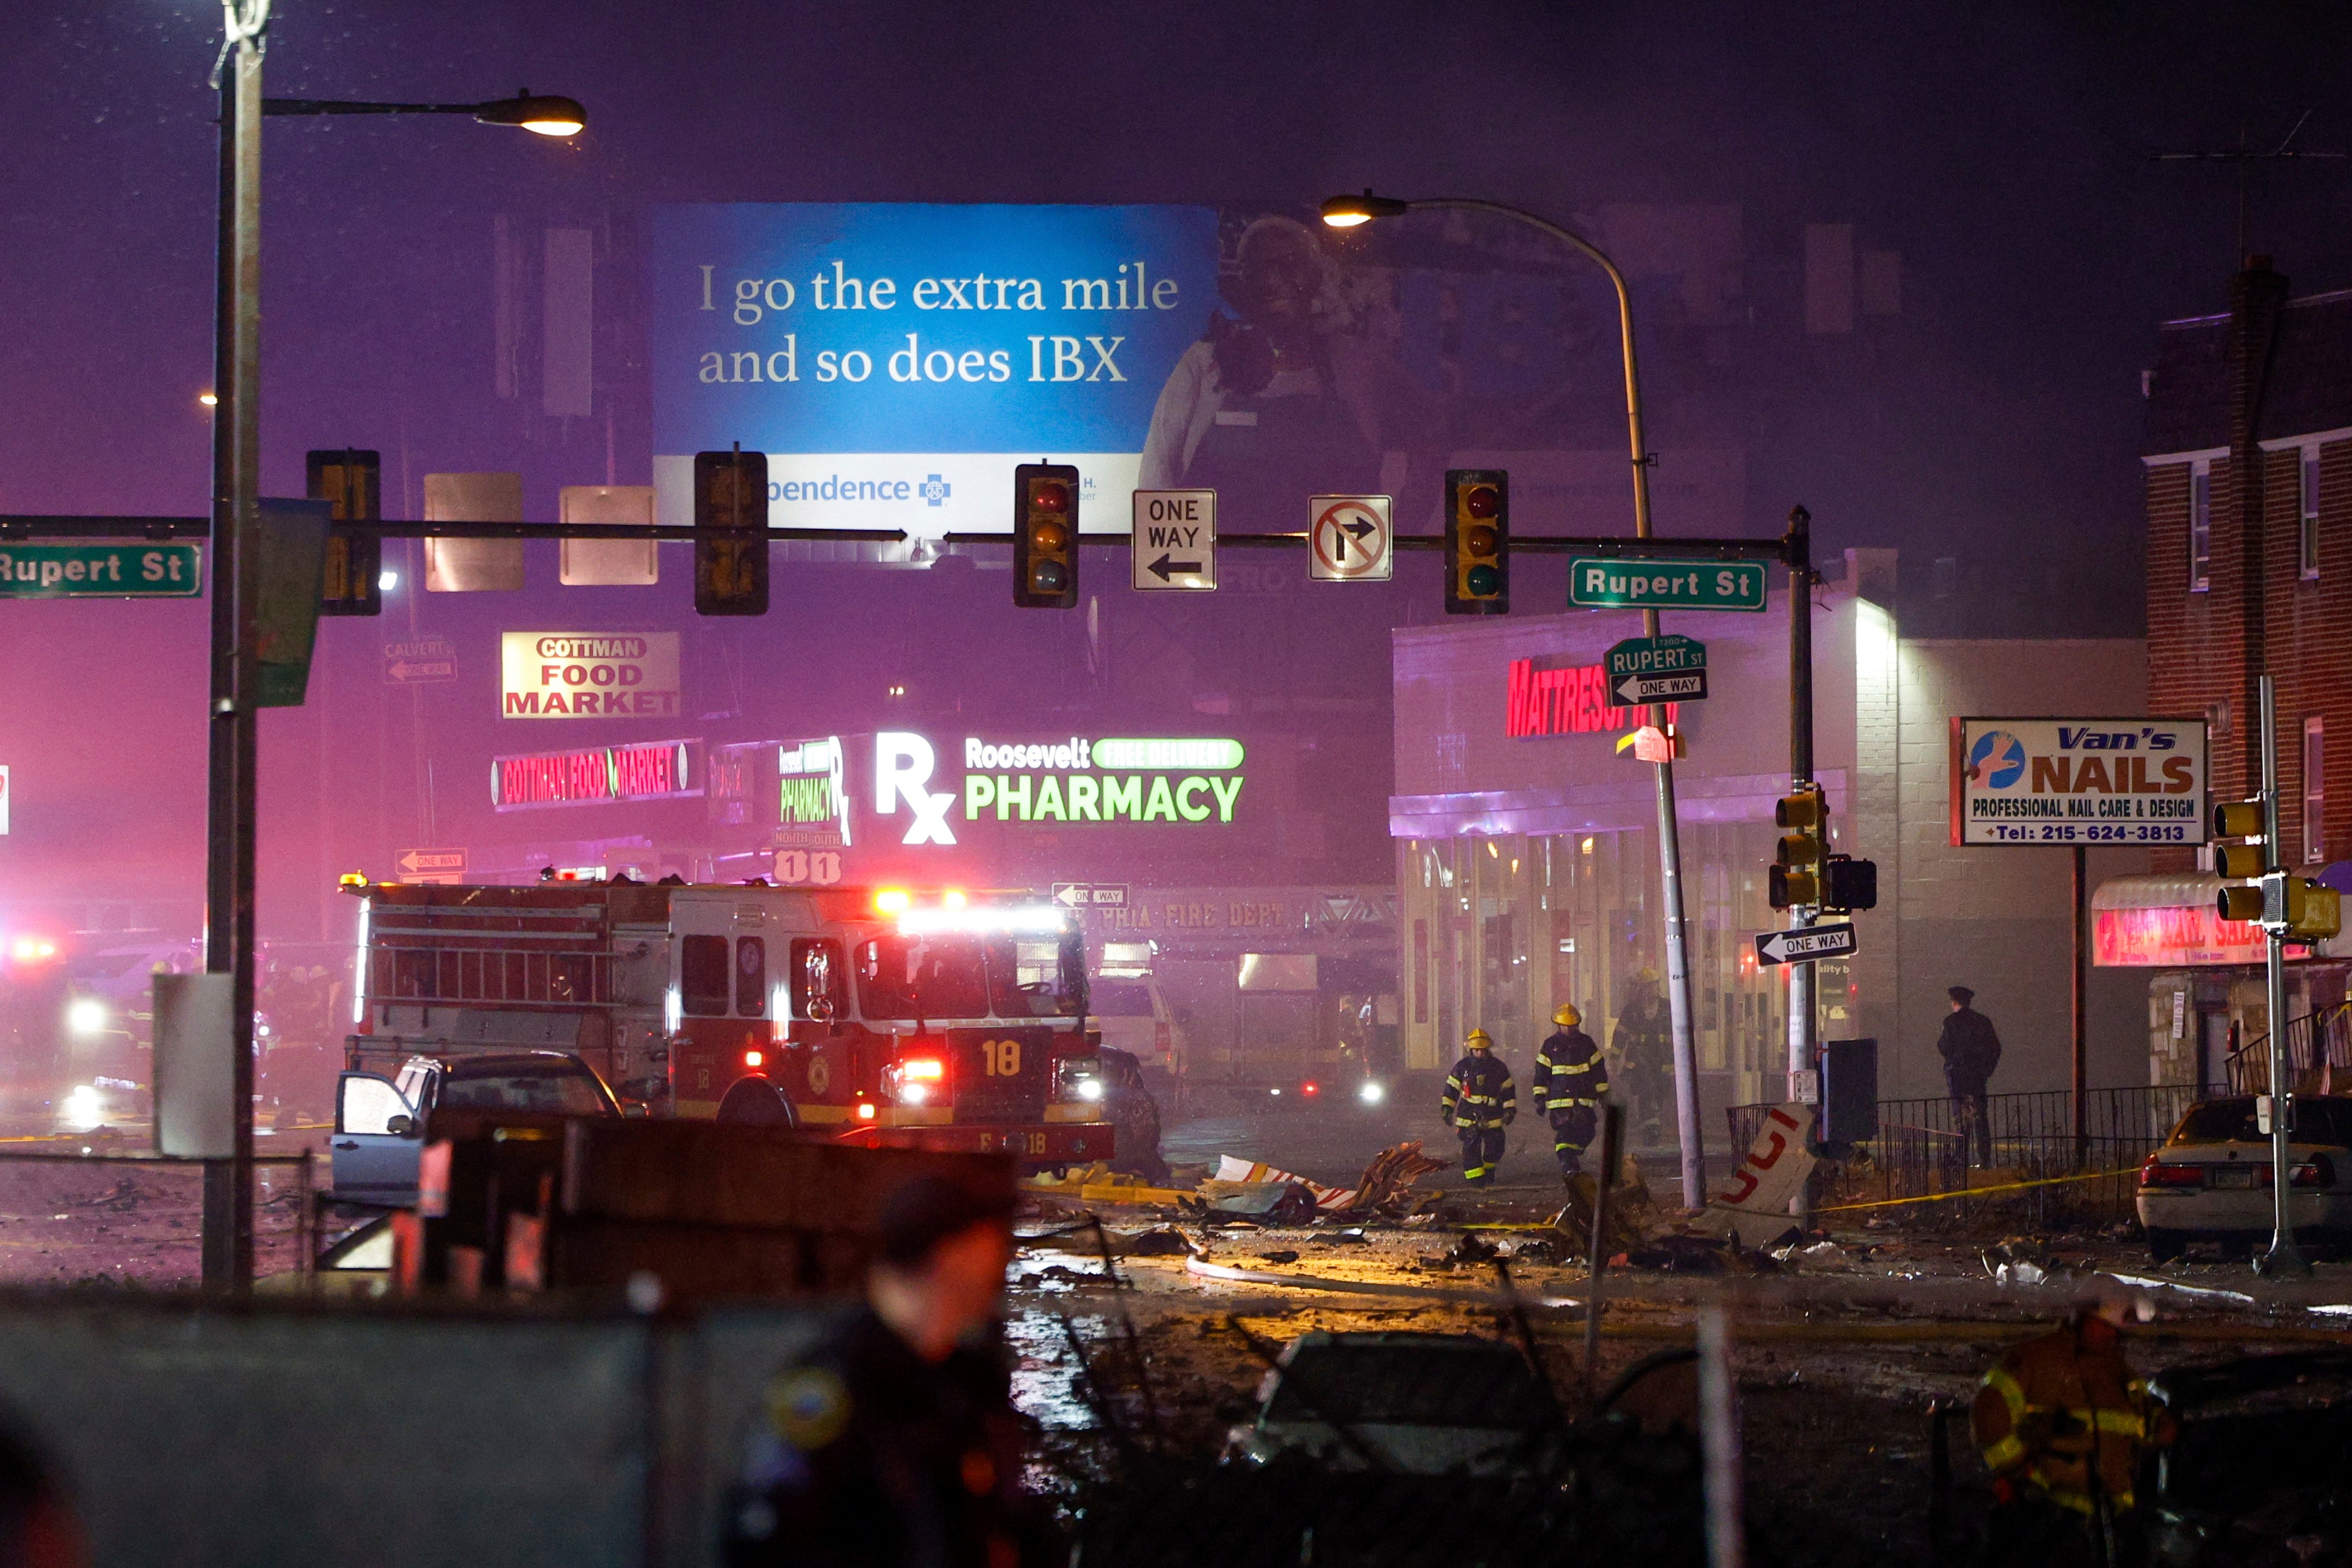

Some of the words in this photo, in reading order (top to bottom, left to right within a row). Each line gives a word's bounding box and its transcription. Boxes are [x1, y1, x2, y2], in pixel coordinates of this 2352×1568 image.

[699, 264, 715, 310] I
[732, 278, 795, 325] go
[811, 261, 896, 310] the
[913, 273, 1045, 310] extra
[1062, 261, 1179, 310] mile
[699, 334, 799, 383] and
[817, 349, 872, 382] so
[888, 334, 1010, 382] does
[1028, 336, 1128, 382] IBX
[767, 474, 910, 501] pendence
[1079, 491, 1096, 500] ber
[1149, 500, 1198, 520] ONE
[1148, 526, 1199, 547] WAY
[0, 553, 121, 586] Rupert
[142, 552, 182, 581] St
[1586, 569, 1698, 597] Rupert
[1716, 571, 1750, 596] St
[541, 639, 638, 656] COTTMAN
[1613, 648, 1686, 672] RUPERT
[1690, 653, 1702, 665] ST
[542, 665, 642, 685] FOOD
[1640, 680, 1665, 694] ONE
[1670, 678, 1696, 692] WAY
[506, 692, 679, 713] MARKET
[2057, 726, 2176, 749] Van's
[965, 737, 1090, 769] Roosevelt
[1104, 741, 1144, 766] FREE
[1148, 741, 1230, 766] DELIVERY
[504, 756, 565, 803] COTTMAN
[569, 753, 606, 799] FOOD
[615, 746, 672, 797] MARKET
[2032, 756, 2193, 793] NAILS
[876, 732, 957, 844] Rx
[965, 774, 1244, 822] PHARMACY
[780, 777, 830, 822] PHARMACY
[1973, 798, 2062, 817] PROFESSIONAL
[2068, 798, 2094, 817] NAIL
[2098, 798, 2132, 817] CARE
[2136, 799, 2143, 816] &
[2150, 798, 2194, 817] DESIGN
[775, 832, 808, 842] NORTH
[1996, 825, 2034, 840] Tel:
[2042, 825, 2184, 840] 215-624-3813
[418, 857, 436, 865] ONE
[440, 856, 458, 865] WAY
[786, 855, 793, 877] 1
[819, 856, 827, 879] 1
[1075, 891, 1088, 900] ON
[1099, 891, 1119, 901] WAY
[1787, 937, 1812, 952] ONE
[1817, 933, 1844, 947] WAY
[983, 1040, 1020, 1076] 18
[1029, 1132, 1045, 1154] 18
